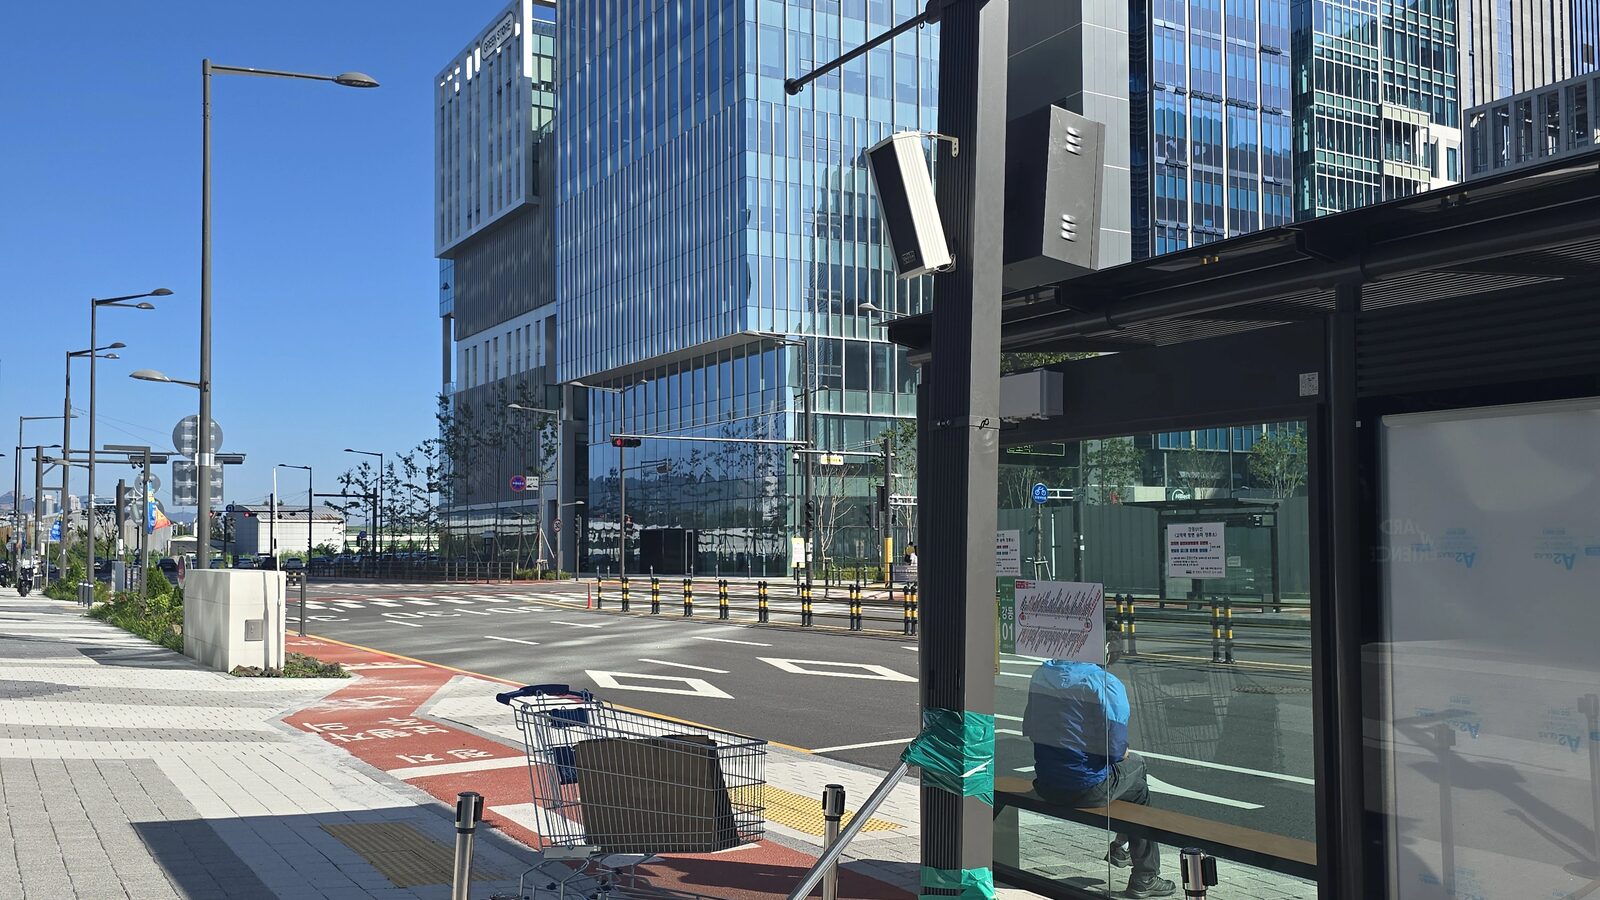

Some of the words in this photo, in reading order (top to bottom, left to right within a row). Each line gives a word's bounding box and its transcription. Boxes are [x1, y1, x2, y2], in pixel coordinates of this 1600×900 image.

[1001, 606, 1013, 621] 강동
[1002, 622, 1014, 641] 01
[395, 748, 493, 764] 정지
